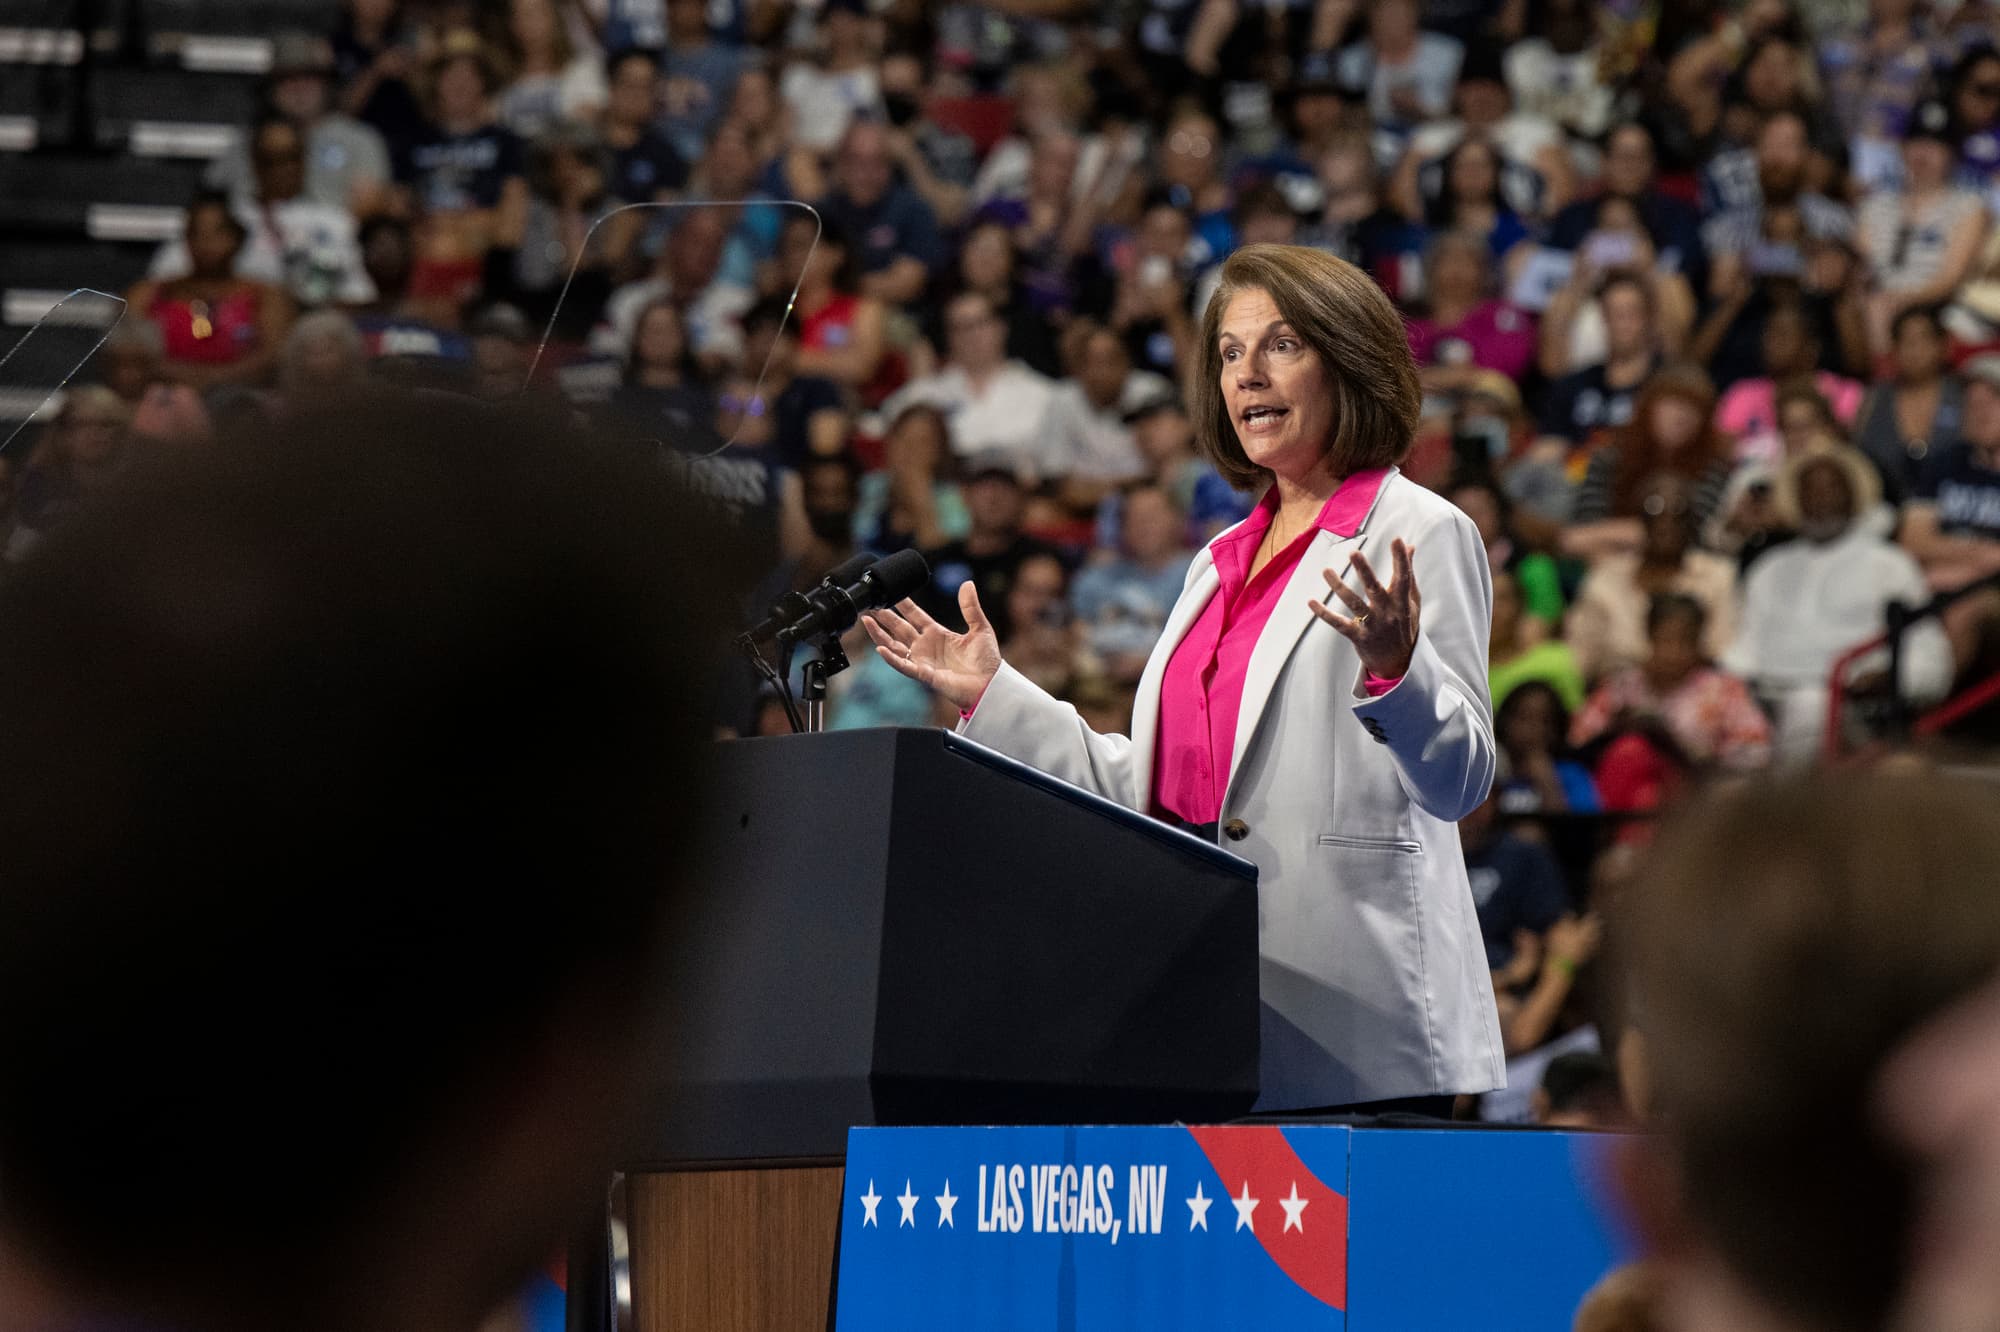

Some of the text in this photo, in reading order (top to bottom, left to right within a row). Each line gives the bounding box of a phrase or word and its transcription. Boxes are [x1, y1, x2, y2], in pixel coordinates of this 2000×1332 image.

[977, 1164, 1168, 1245] LAS VEGAS, NV
